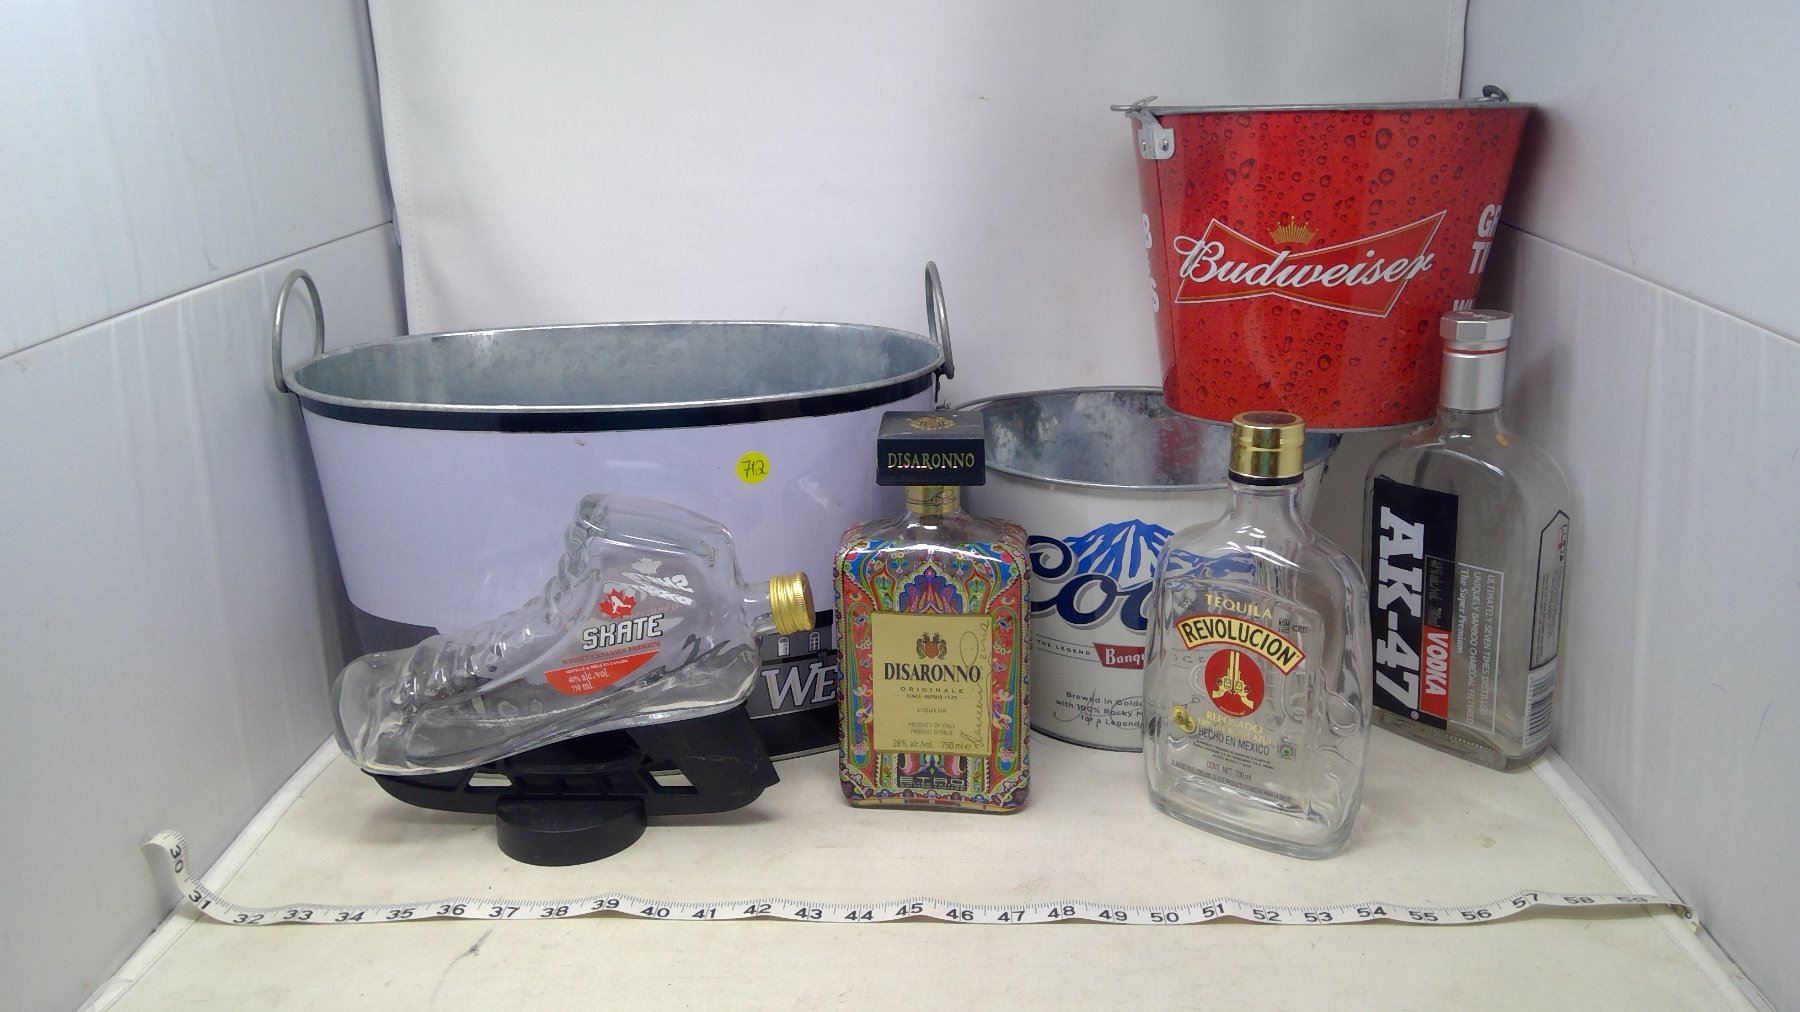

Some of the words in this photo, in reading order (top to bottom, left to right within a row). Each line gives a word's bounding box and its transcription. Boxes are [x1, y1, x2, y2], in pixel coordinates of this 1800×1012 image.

[1173, 235, 1435, 289] Budweiser
[741, 459, 767, 478] 712
[887, 452, 975, 469] DISARONNO
[1460, 569, 1469, 586] The
[1206, 594, 1272, 619] TEQUILA
[1375, 505, 1425, 711] AK-47
[1456, 586, 1468, 613] Super
[582, 613, 665, 651] SKATE
[1181, 619, 1297, 667] REVOLUCION
[1036, 639, 1052, 648] THE
[1055, 644, 1092, 656] LEGEND
[884, 662, 981, 683] DISARONNO
[1424, 632, 1449, 696] VODKA
[761, 661, 838, 710] WE
[900, 686, 964, 694] ORIGINALE
[1066, 691, 1101, 704] Brewed
[1104, 708, 1133, 718] Rocky
[892, 739, 908, 748] 28%
[941, 741, 954, 750] 750
[1198, 727, 1224, 743] HECHO
[1225, 735, 1236, 748] EN
[1237, 739, 1270, 756] MEXICO
[168, 843, 185, 874] 30
[187, 889, 211, 910] 31
[232, 913, 263, 925] 32
[282, 908, 314, 921] 33
[333, 910, 364, 923] 34
[385, 906, 417, 921] 35
[436, 903, 467, 917] 36
[488, 906, 521, 918] 37
[539, 905, 570, 918] 38
[590, 898, 620, 910] 39
[640, 905, 670, 918] 40
[691, 907, 717, 919] 41
[742, 903, 772, 915] 42
[794, 907, 823, 920] 43
[844, 909, 874, 921] 44
[895, 902, 924, 916] 45
[945, 908, 975, 921] 46
[997, 909, 1026, 922] 47
[1047, 905, 1076, 918] 48
[1098, 908, 1128, 921] 49
[1149, 910, 1180, 923] 50
[1202, 902, 1225, 918] 51
[1252, 908, 1282, 922] 52
[1303, 910, 1334, 923] 53
[1355, 905, 1387, 918] 54
[1408, 909, 1439, 922] 55
[1461, 908, 1493, 922] 56
[1512, 893, 1540, 909] 57
[1562, 895, 1595, 905] 58
